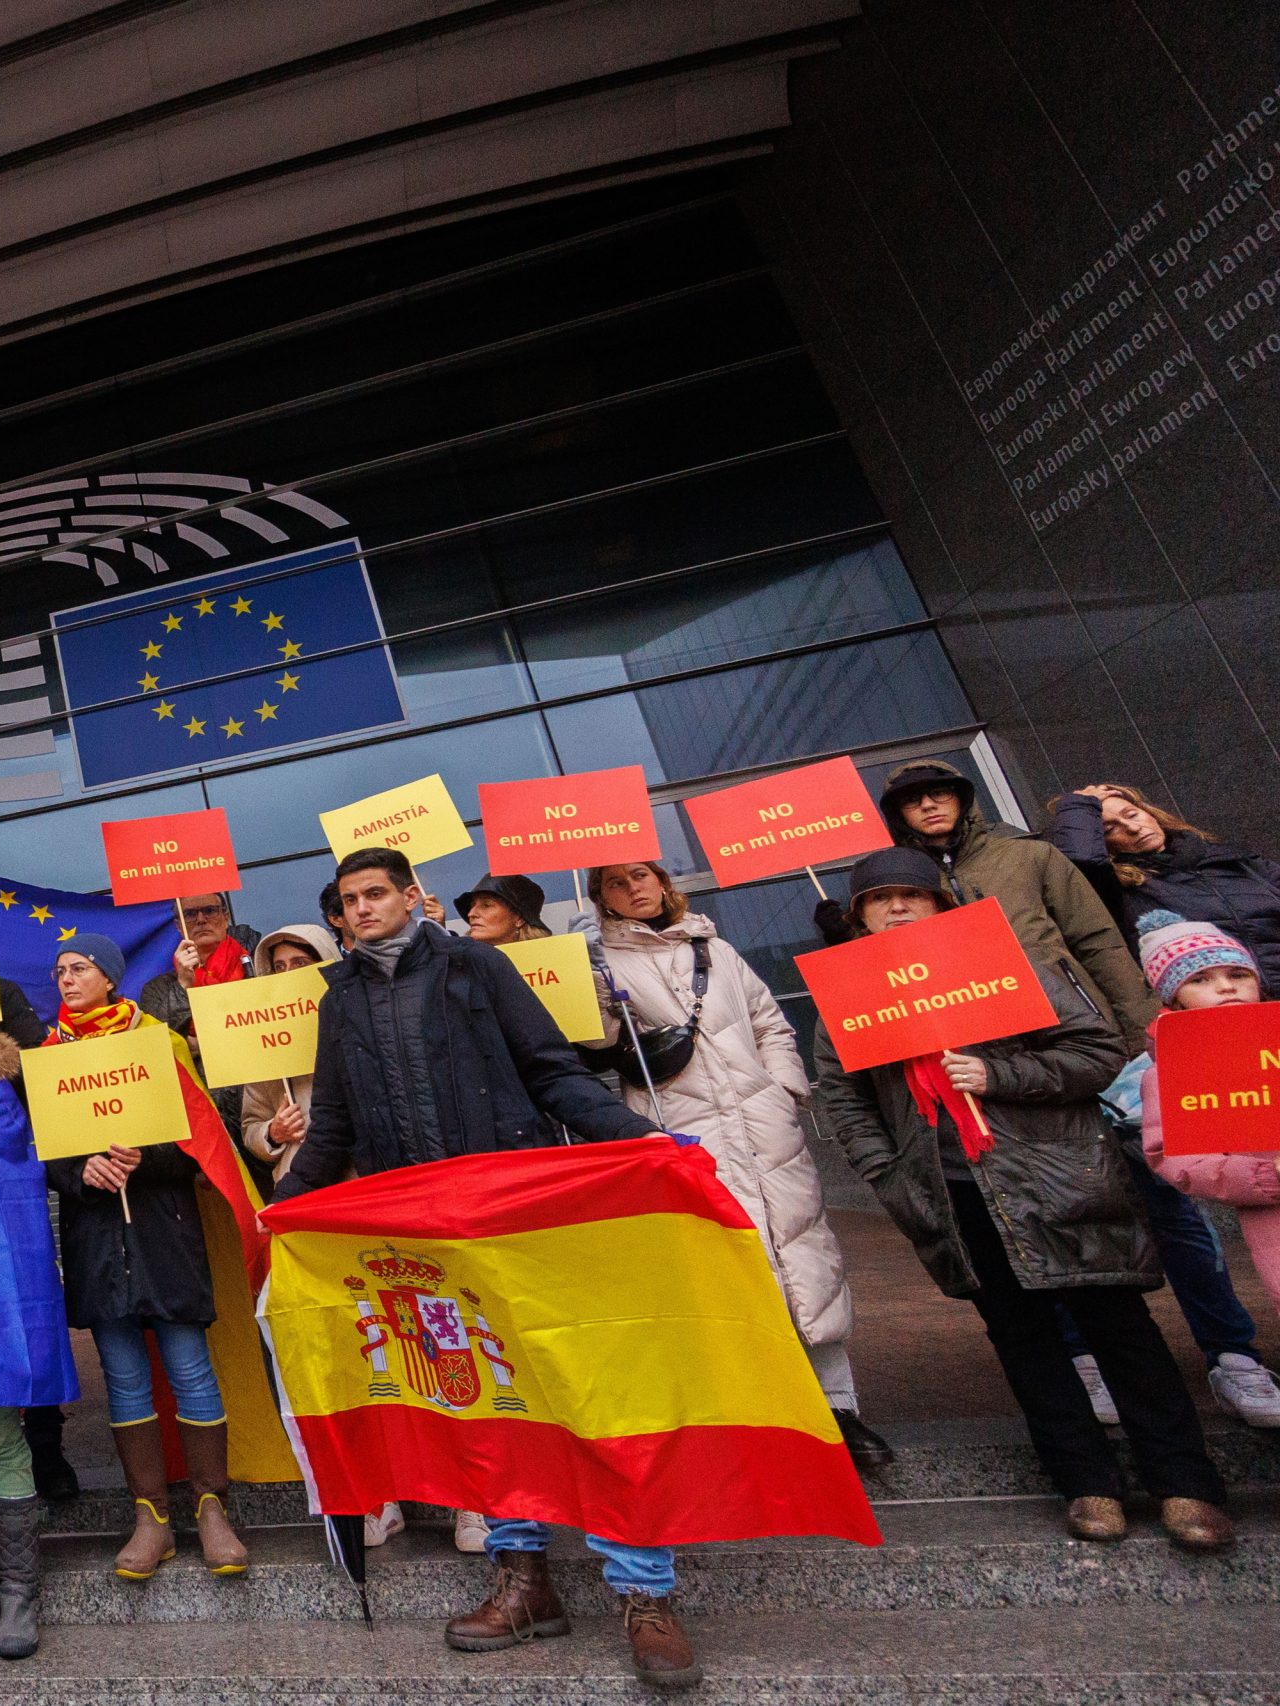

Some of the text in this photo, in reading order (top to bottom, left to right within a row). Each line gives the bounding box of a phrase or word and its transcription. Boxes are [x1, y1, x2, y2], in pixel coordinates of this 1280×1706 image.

[963, 200, 1167, 401] Европейски парламент
[979, 279, 1142, 434] Euroopa Parlament
[996, 395, 1067, 465] Europski
[1068, 312, 1168, 410] parlament
[1012, 420, 1102, 498] Parlament
[1100, 347, 1194, 427] Ewropew
[1030, 463, 1109, 532] Európsky
[1111, 381, 1218, 480] parlament
[353, 804, 429, 839] AMNISTÍA
[544, 803, 577, 820] NO
[758, 803, 794, 823] NO
[152, 840, 178, 854] NO
[384, 831, 410, 848] NO
[499, 821, 640, 847] en mi nombre
[719, 811, 864, 856] en mi nombre
[120, 856, 225, 879] en mi nombre
[886, 962, 929, 988] NO
[225, 997, 318, 1029] AMNISTÍA
[842, 975, 1019, 1032] en mi nombre
[261, 1031, 292, 1049] NO
[57, 1064, 150, 1096] AMNISTÍA
[93, 1098, 123, 1118] NO
[1180, 1084, 1271, 1111] en mi
